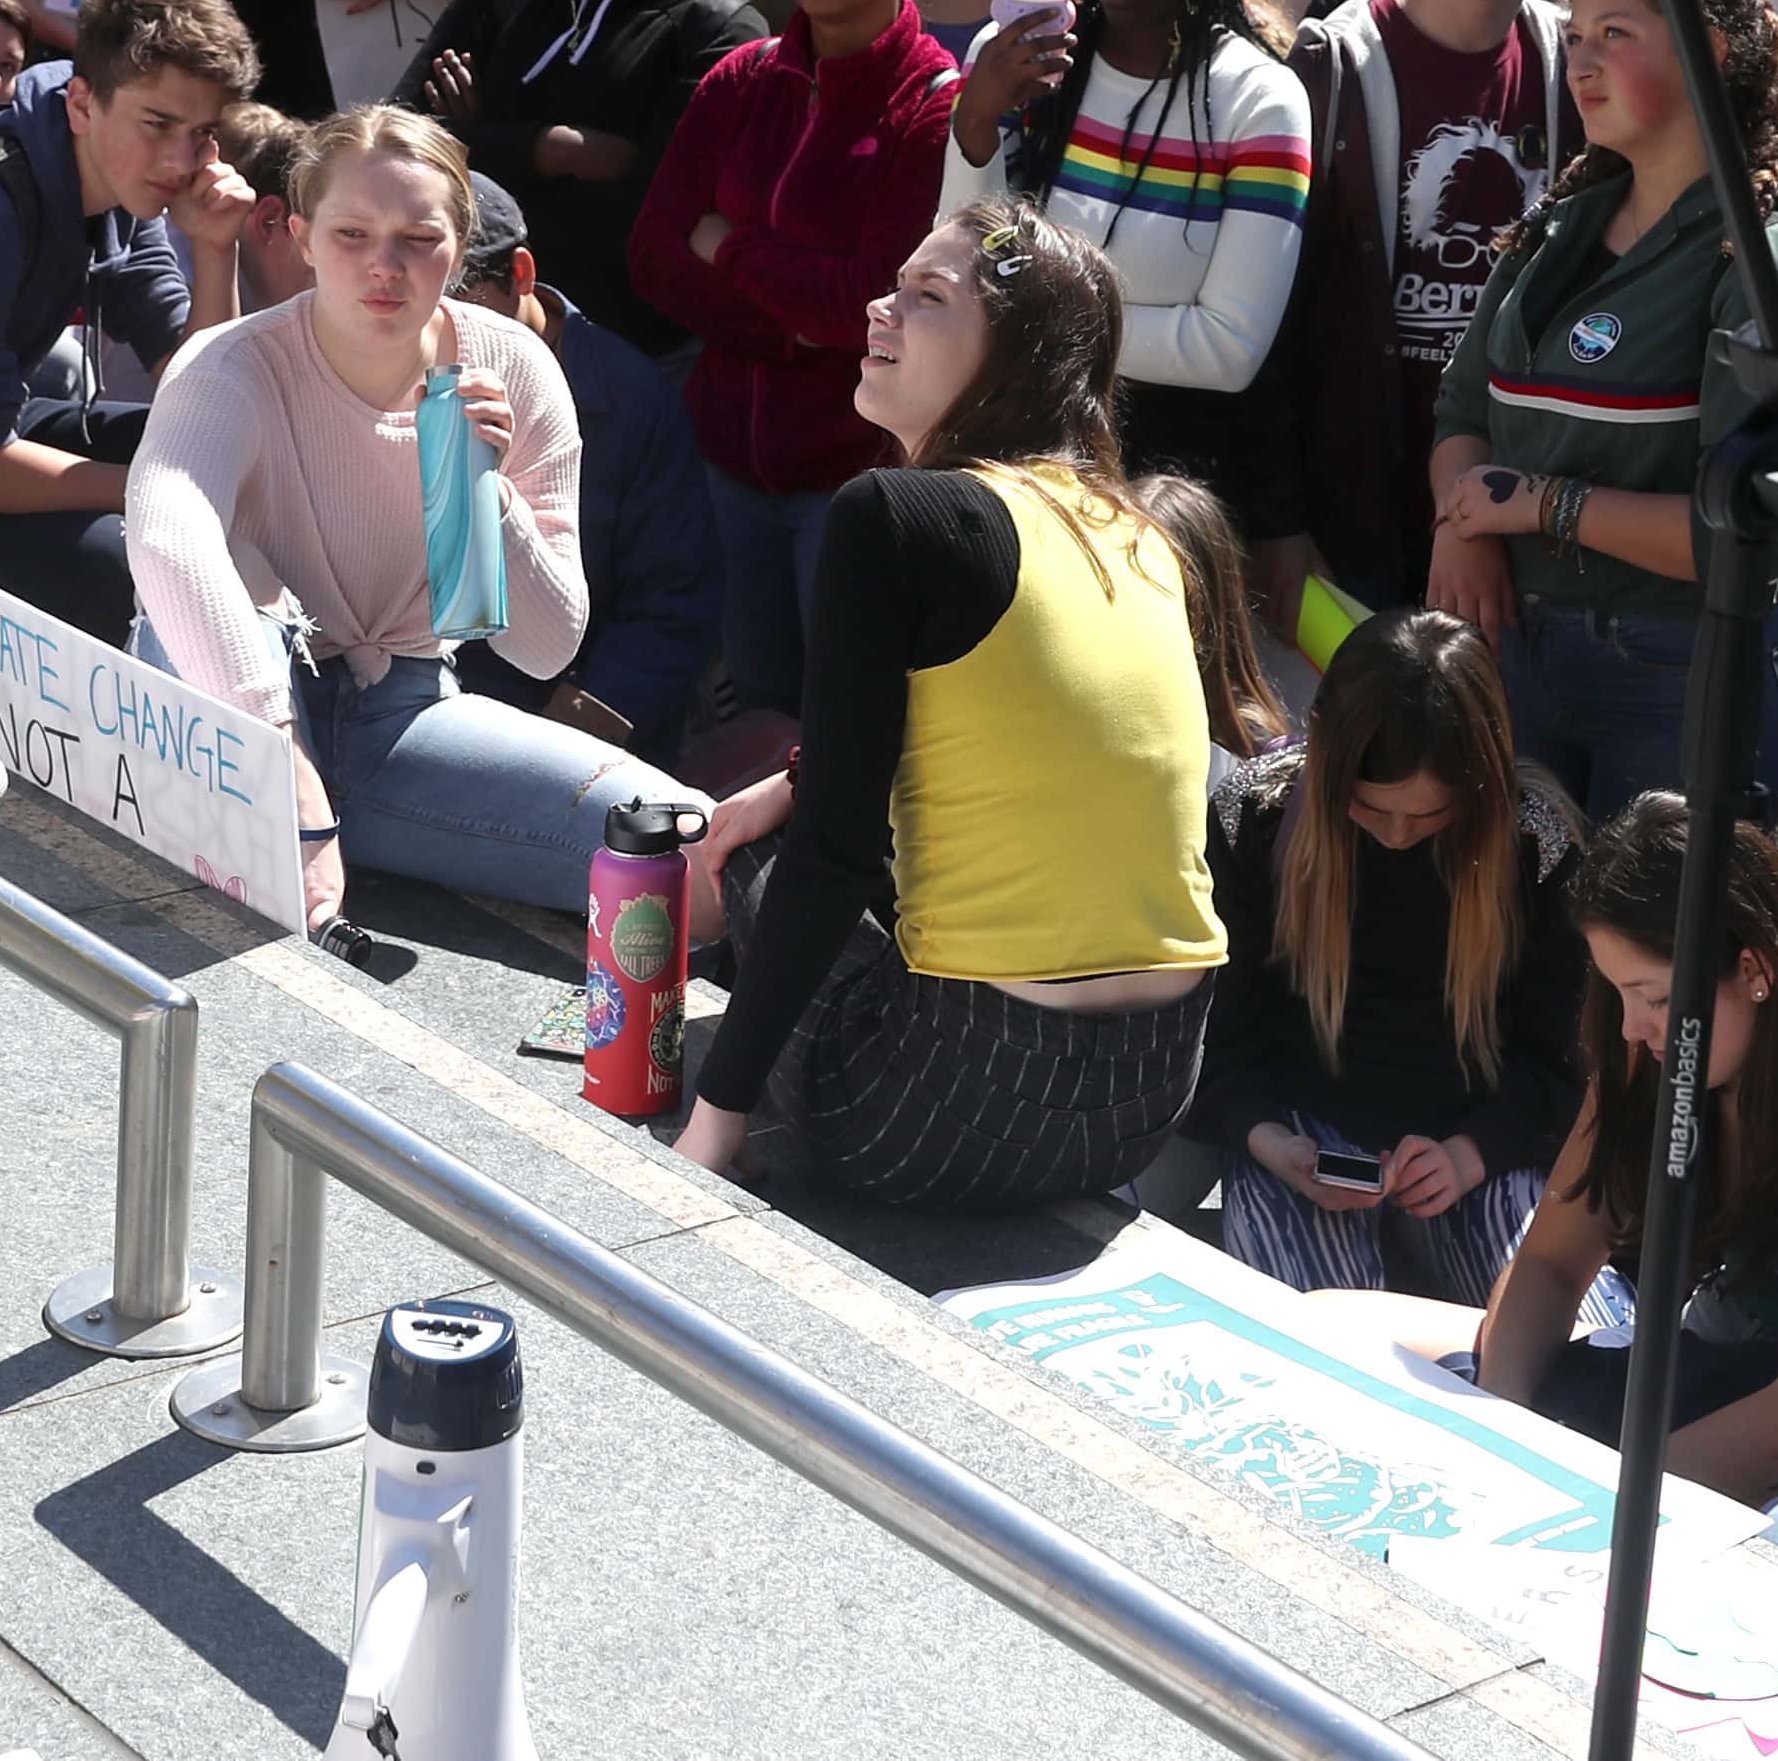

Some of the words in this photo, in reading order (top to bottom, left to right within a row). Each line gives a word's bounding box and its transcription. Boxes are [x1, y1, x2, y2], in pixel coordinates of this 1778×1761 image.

[89, 664, 253, 807] CHANGE
[112, 754, 146, 836] A
[1667, 1017, 1702, 1178] amazonbasics
